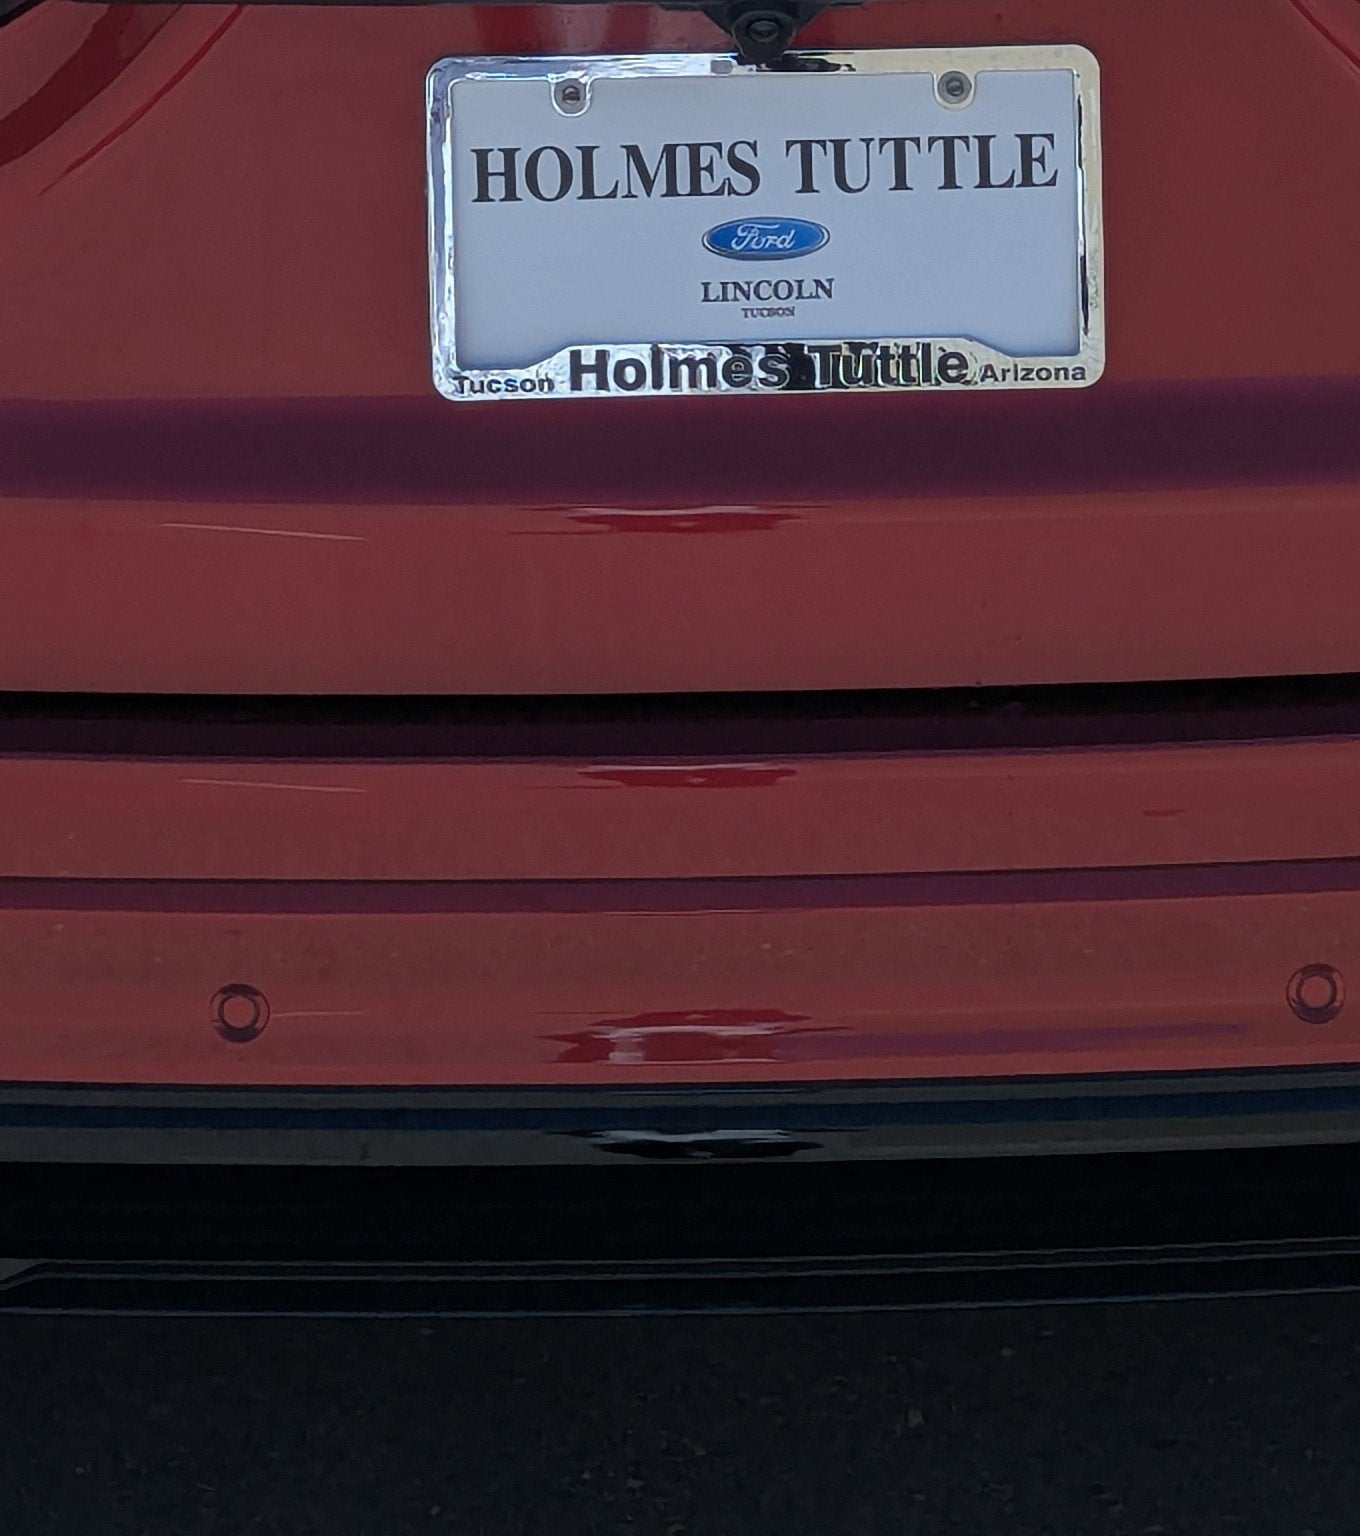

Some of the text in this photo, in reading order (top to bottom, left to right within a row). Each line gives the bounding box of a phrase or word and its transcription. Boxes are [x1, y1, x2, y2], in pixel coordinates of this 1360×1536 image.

[471, 133, 1059, 203] HOLMES TUTTLE
[731, 223, 796, 251] Ford
[701, 278, 835, 302] LINCOLN
[741, 306, 795, 319] TUCSON
[452, 342, 1087, 395] Tucson Holmes Tuttle Arizona
